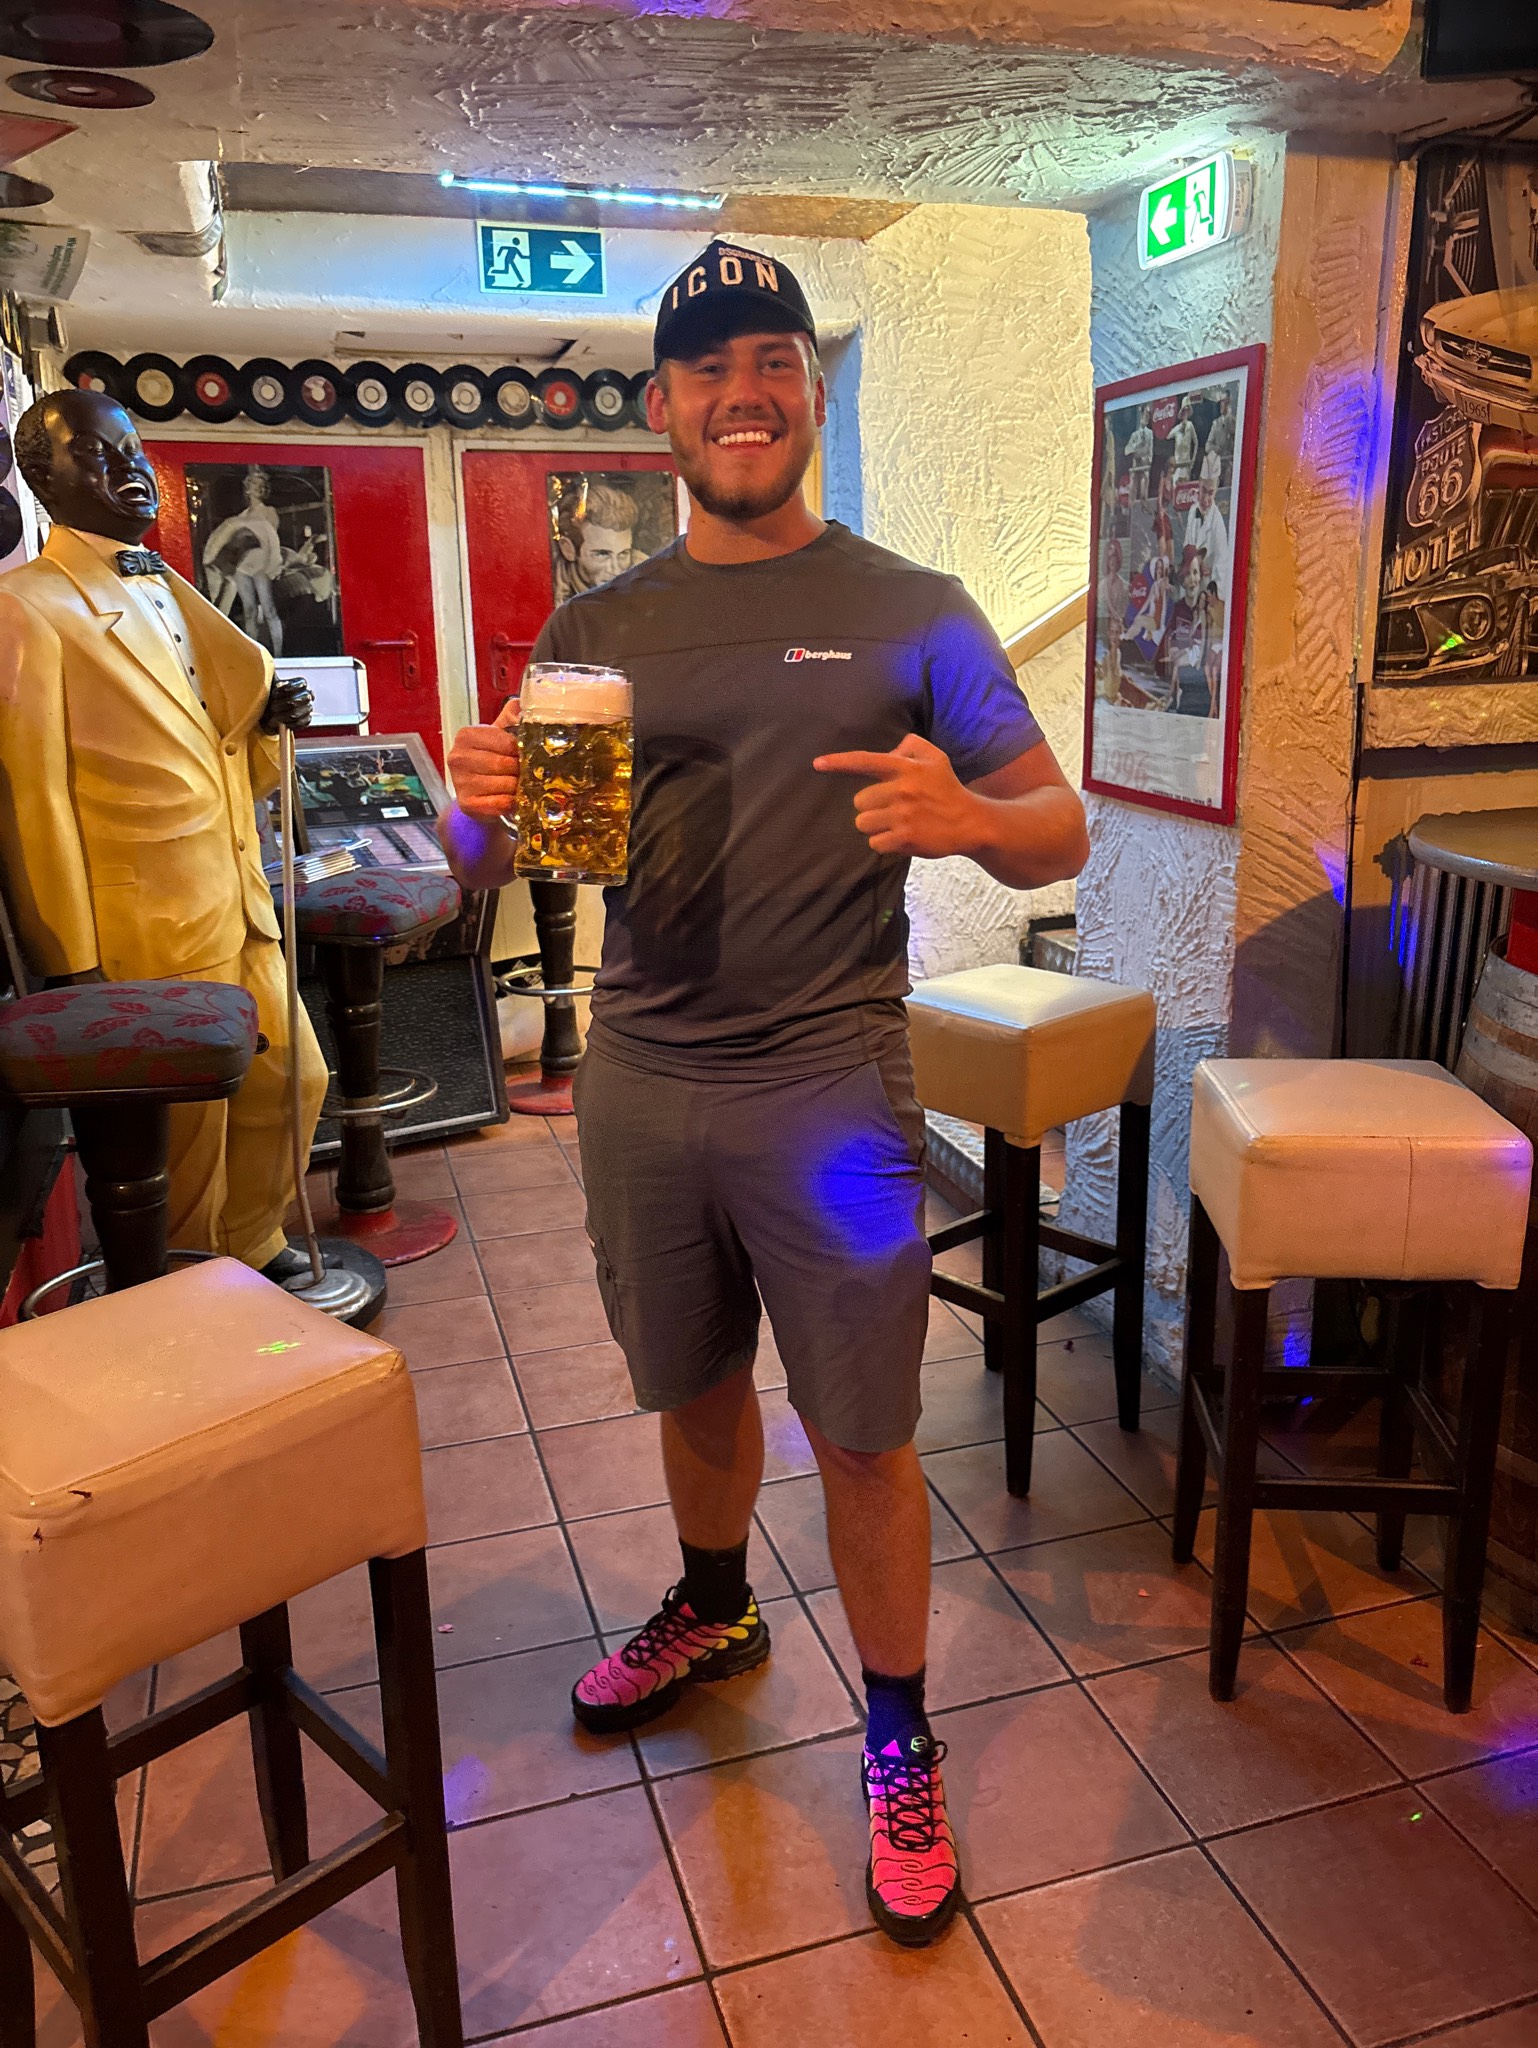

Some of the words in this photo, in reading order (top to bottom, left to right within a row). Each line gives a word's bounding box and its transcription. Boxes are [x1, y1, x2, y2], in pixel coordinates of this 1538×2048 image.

[672, 256, 778, 310] ICON
[1464, 401, 1486, 418] 1965
[1418, 458, 1464, 520] 66
[1383, 511, 1481, 596] MOTEL
[805, 650, 852, 660] berghaus
